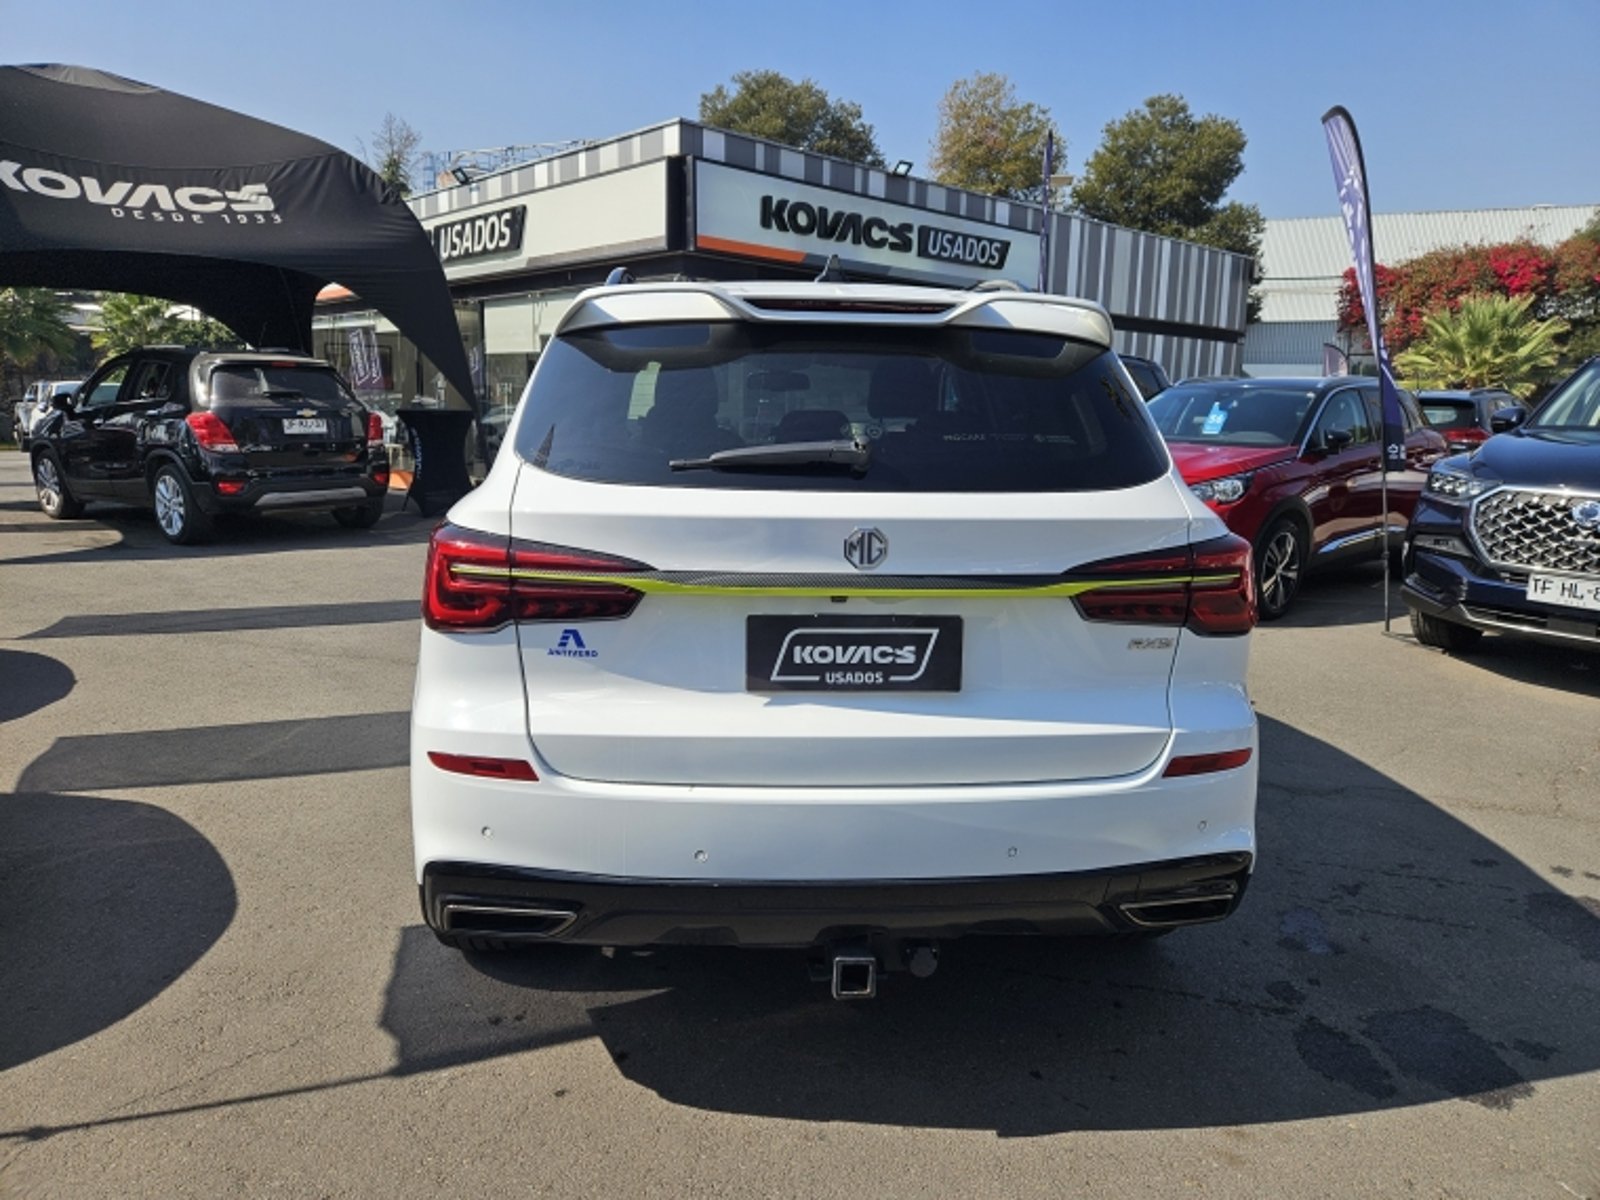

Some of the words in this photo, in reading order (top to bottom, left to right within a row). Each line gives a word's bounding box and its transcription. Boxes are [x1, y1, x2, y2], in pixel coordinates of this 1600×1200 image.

[0, 160, 274, 213] KOVACS
[111, 207, 203, 224] DESDE
[760, 195, 914, 253] KOVACS
[927, 230, 1001, 266] USADOS
[440, 212, 511, 260] USADOS
[848, 531, 883, 565] MG
[793, 645, 916, 665] KOVACS
[825, 671, 883, 684] USADOS
